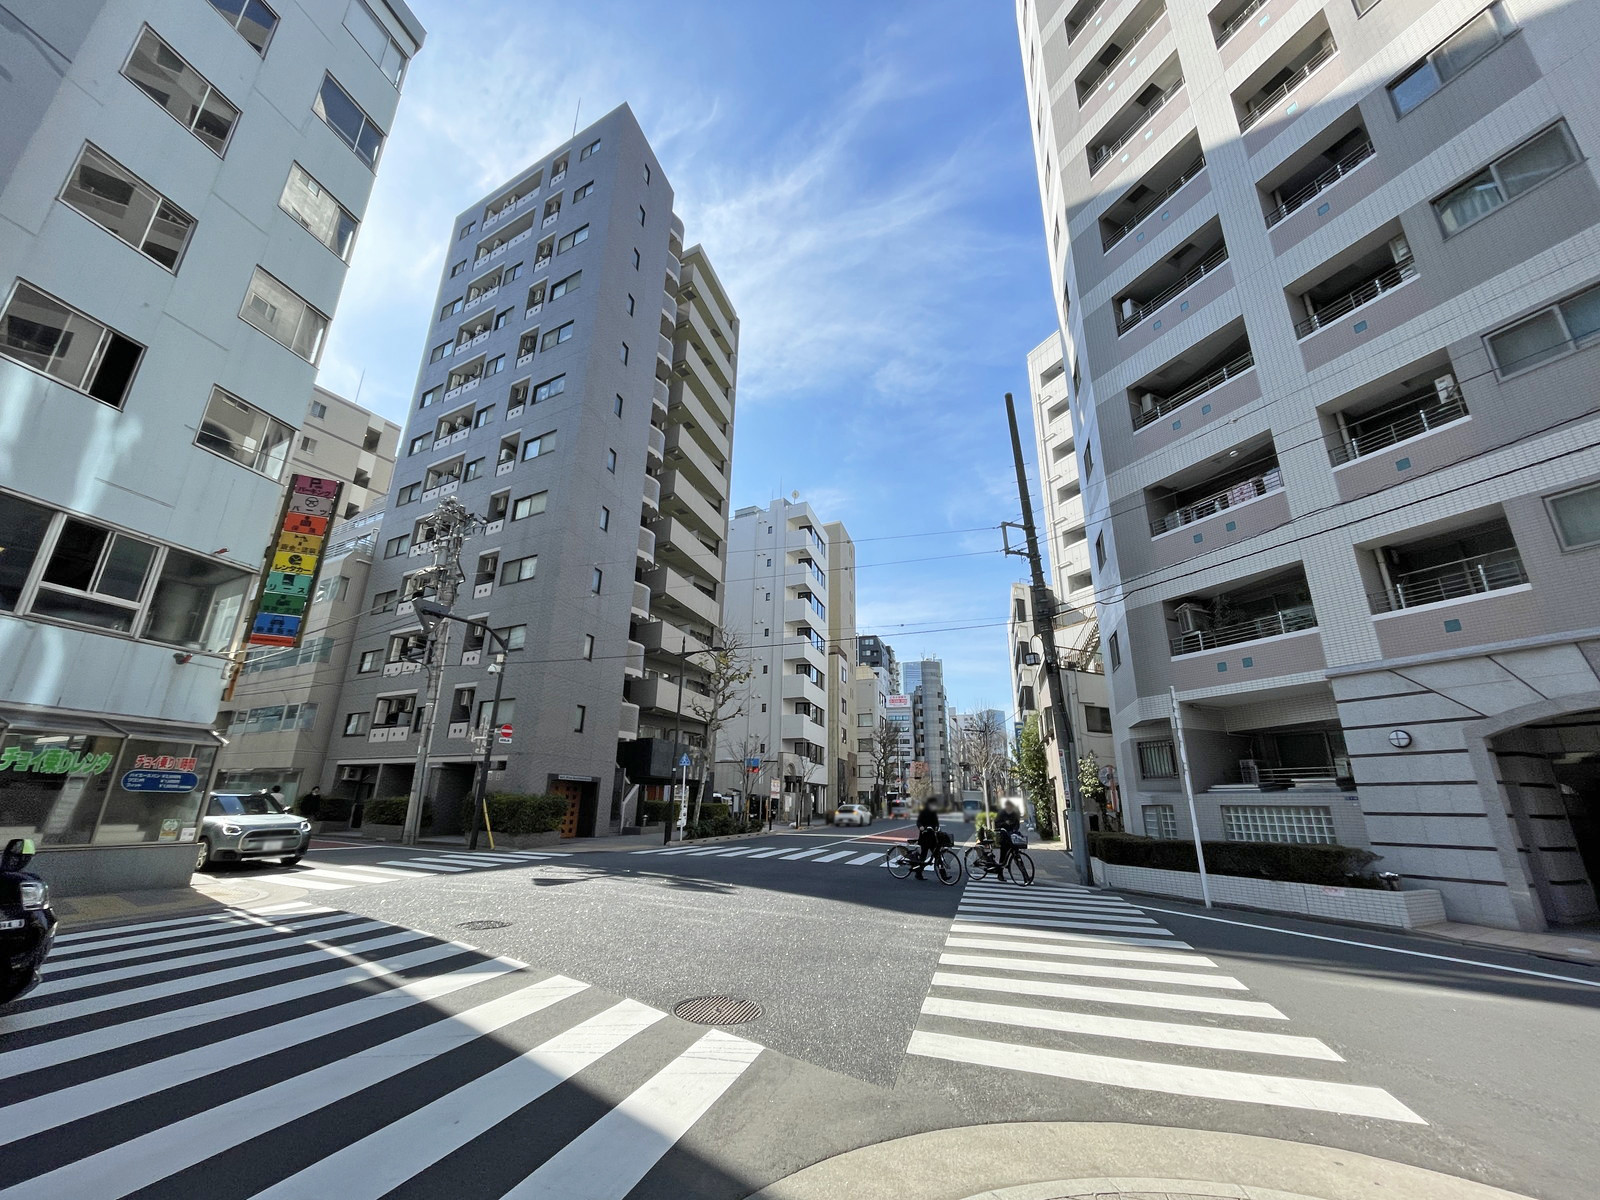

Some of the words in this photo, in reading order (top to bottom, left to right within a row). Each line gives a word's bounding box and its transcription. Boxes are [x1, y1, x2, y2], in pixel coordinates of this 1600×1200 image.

[298, 487, 332, 497] パーキング
[292, 505, 327, 516] パーツ
[275, 563, 312, 573] レンタカー
[269, 583, 305, 594] リース
[0, 746, 113, 776] チョイ乗りレンタ
